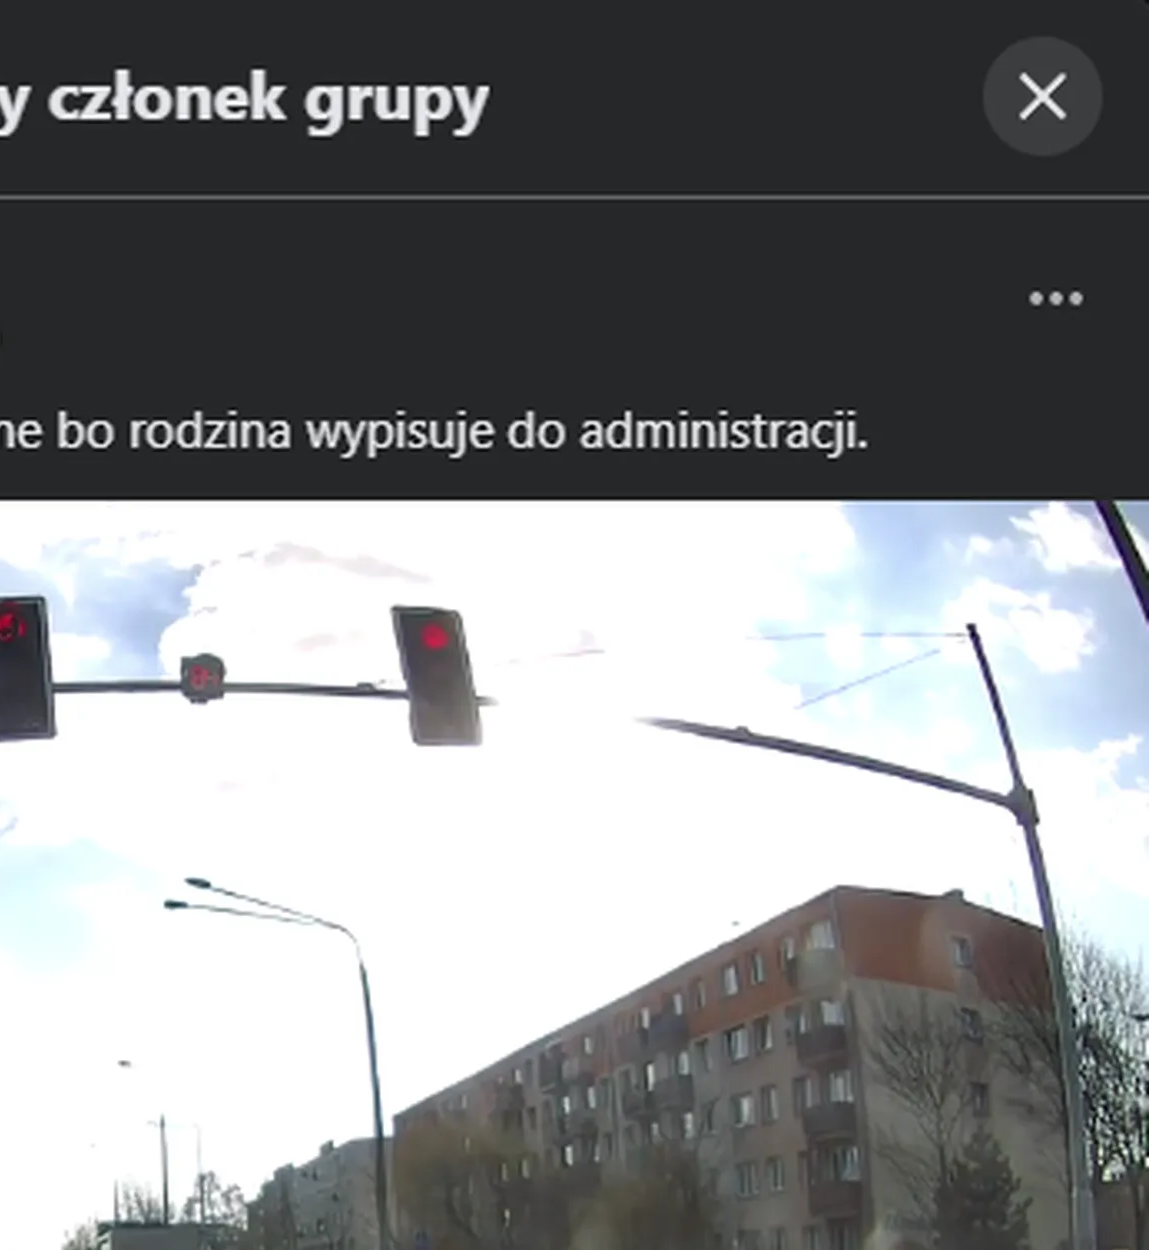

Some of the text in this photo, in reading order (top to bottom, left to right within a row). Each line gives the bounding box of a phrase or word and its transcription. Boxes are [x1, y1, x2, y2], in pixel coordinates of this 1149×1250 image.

[48, 69, 287, 120] członek
[304, 85, 490, 137] grupy
[58, 410, 114, 449] bo
[131, 410, 291, 449] rodzina
[305, 410, 496, 459] wypisuje
[507, 410, 566, 449] do
[580, 410, 867, 458] administracji.
